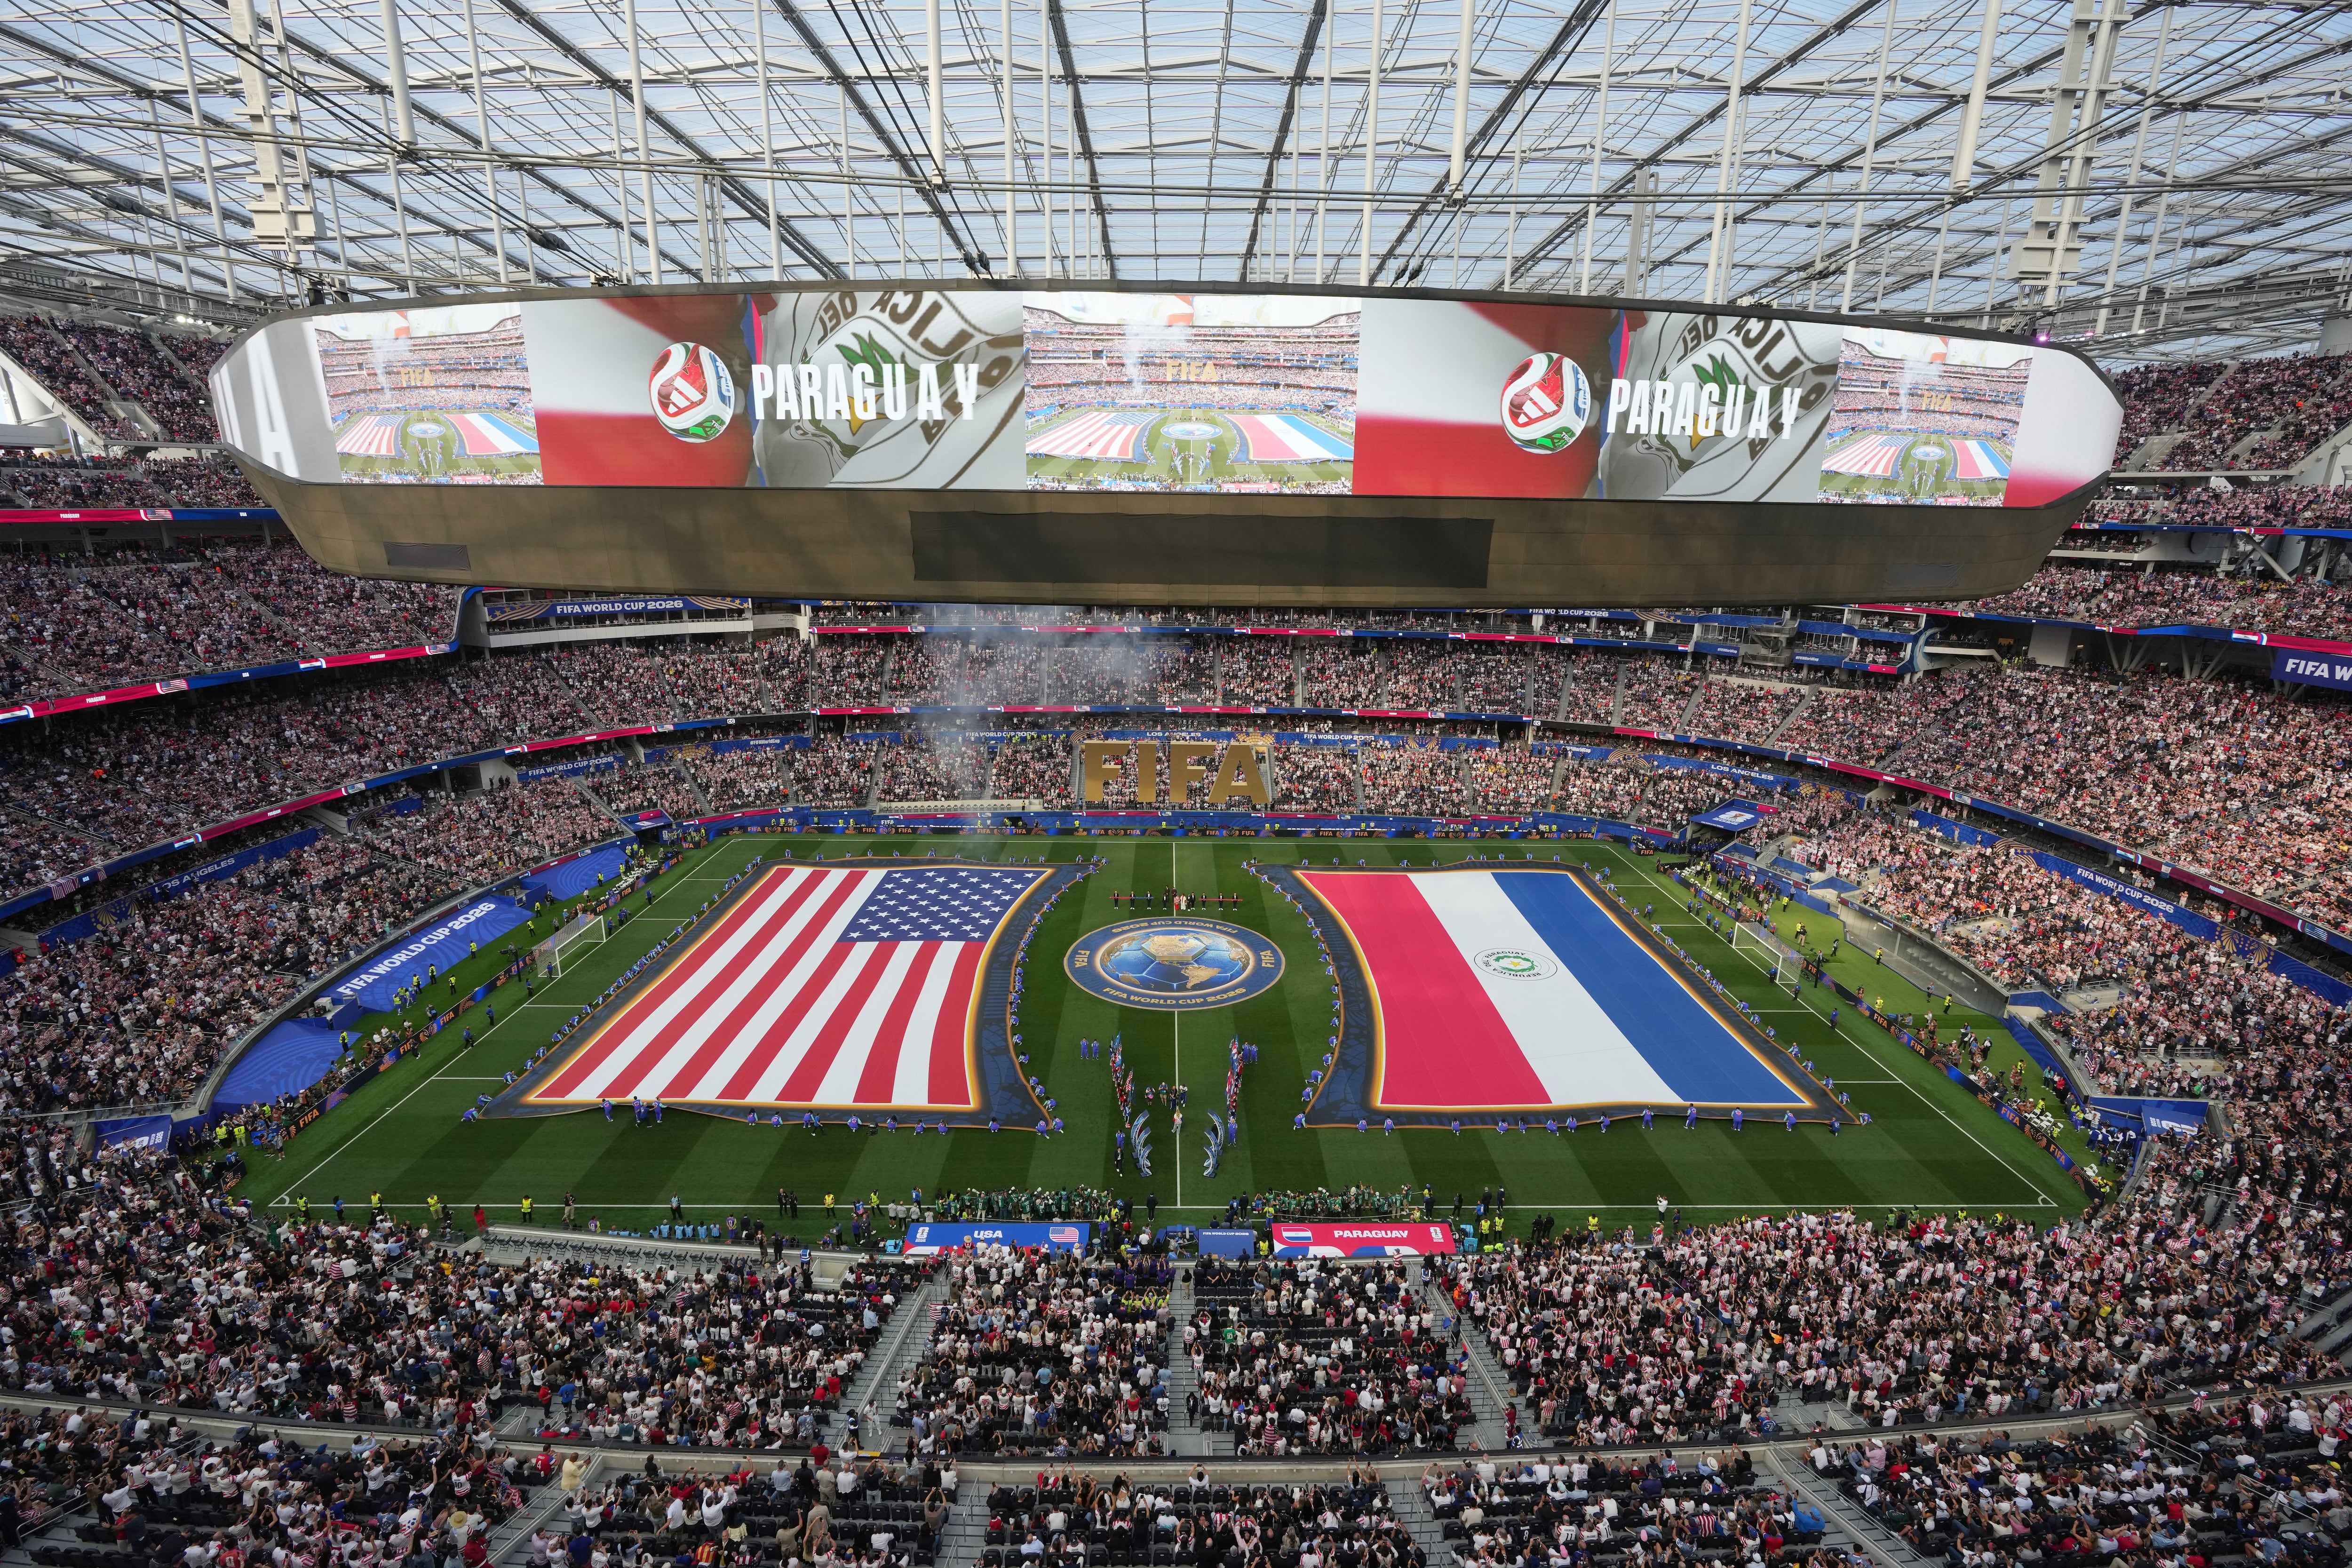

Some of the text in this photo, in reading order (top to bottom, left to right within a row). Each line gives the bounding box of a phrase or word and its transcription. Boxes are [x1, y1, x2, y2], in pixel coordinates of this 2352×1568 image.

[401, 368, 436, 386] FIFA
[1167, 362, 1219, 381] FIFA
[752, 363, 980, 421] PARAGUAY
[1606, 378, 1803, 440] PARAGUAY
[1922, 393, 1952, 410] FIFA
[557, 600, 683, 614] FIFA WORLD CUP 2026
[2285, 658, 2329, 678] FIFA
[545, 764, 572, 773] WORLD
[589, 756, 614, 765] 2026
[1084, 742, 1270, 804] FIFA
[1731, 769, 1774, 780] ANGELES
[155, 858, 235, 893] LOS AGELES
[622, 887, 632, 897] FIFA
[1701, 892, 1710, 902] FIFA
[2077, 868, 2174, 914] FIFA WORLD CUP 2026
[597, 903, 607, 913] FIFA
[1725, 907, 1735, 918] FIFA
[1112, 923, 1149, 933] 2026
[1216, 925, 1238, 934] FIFA
[336, 902, 496, 995] FIFA WORLD CUP 2026
[1074, 950, 1090, 968] FIFA
[1259, 950, 1275, 968] FIFA
[1493, 968, 1542, 978] REPUBLICA
[1103, 987, 1128, 998] FIFA
[1130, 995, 1176, 1004] WORLD
[1206, 987, 1247, 1002] 2026
[440, 1011, 454, 1026] FIFA
[1874, 1013, 1887, 1029] FIFA
[1910, 1039, 1925, 1057] FIFA
[299, 1109, 320, 1128] FIFA
[2001, 1106, 2019, 1127] FIFA
[155, 1131, 164, 1144] 2026
[2050, 1144, 2065, 1165] FIFA
[1524, 1530, 1529, 1540] 8
